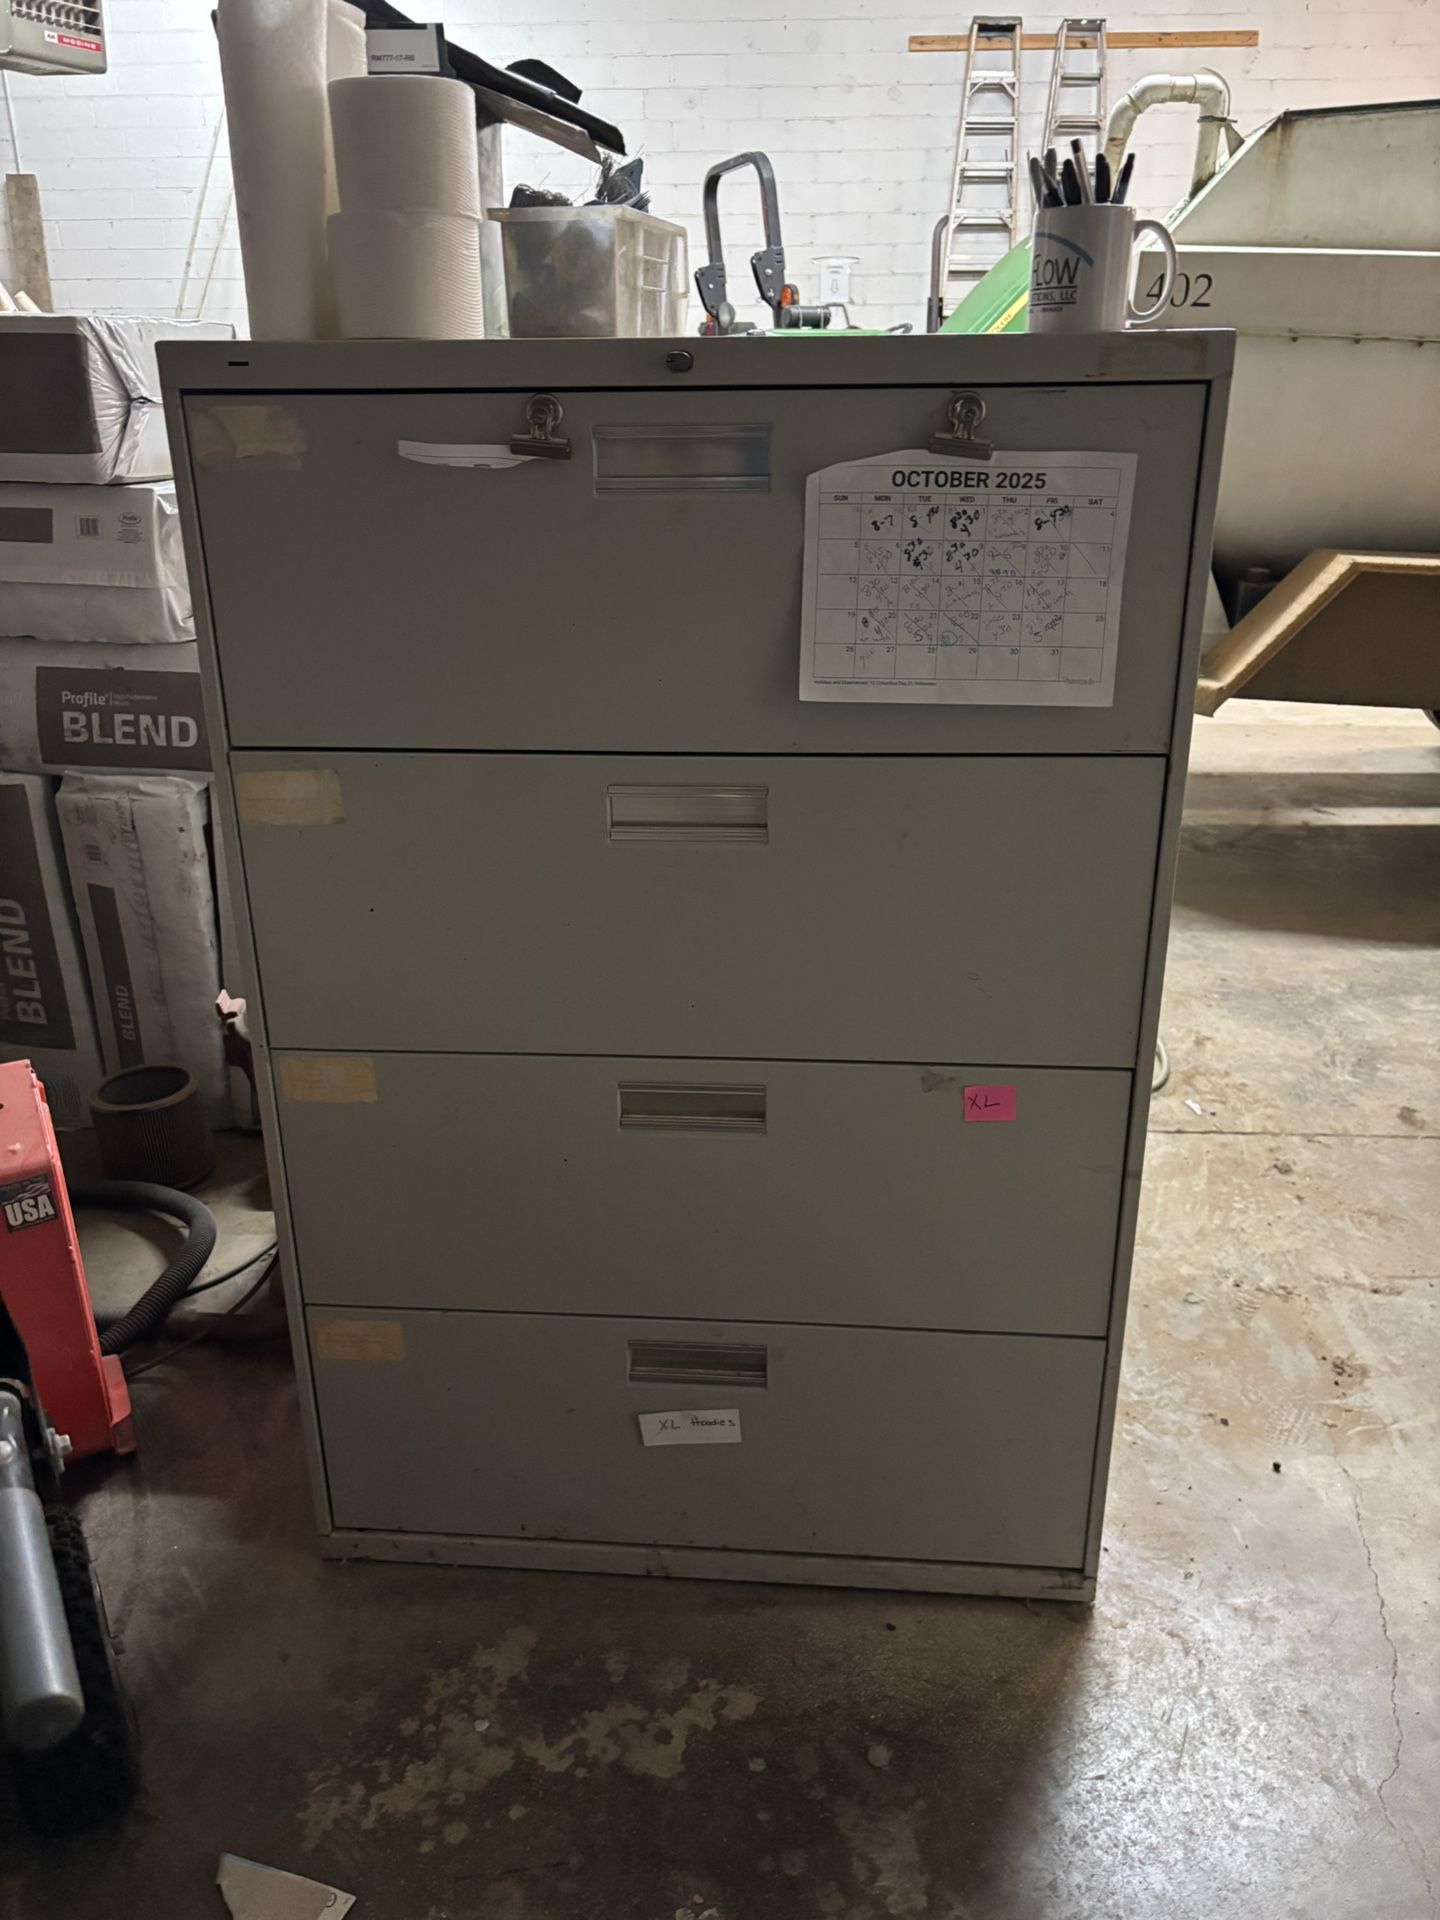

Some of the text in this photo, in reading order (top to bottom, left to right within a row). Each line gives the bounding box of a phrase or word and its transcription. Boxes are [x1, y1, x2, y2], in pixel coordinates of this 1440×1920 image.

[1146, 272, 1213, 308] 402
[891, 470, 1047, 489] OCTOBER 2025
[918, 495, 932, 503] TUE
[1002, 496, 1017, 504] THU
[1087, 498, 1103, 506] SAT
[61, 690, 106, 707] Profile
[62, 711, 199, 748] BLEND
[0, 898, 48, 1025] BLEND
[115, 984, 136, 1040] BLEND
[967, 1093, 1001, 1110] XL
[4, 1194, 56, 1226] USA
[658, 1418, 681, 1431] XL
